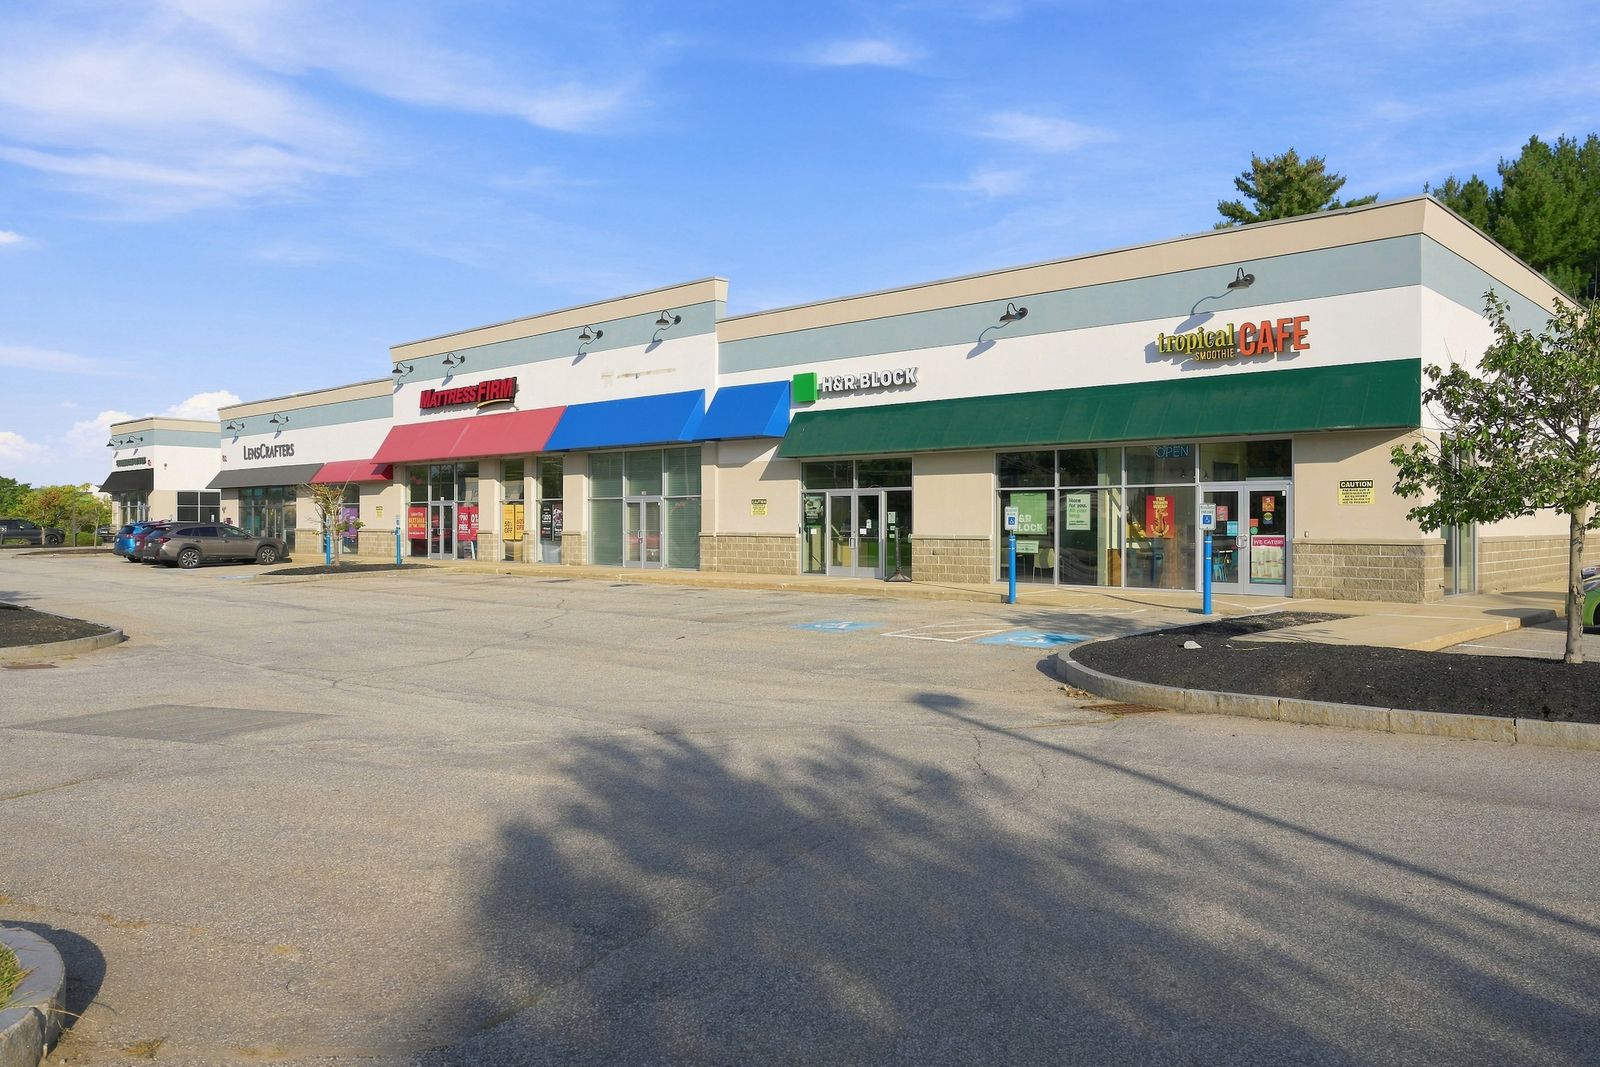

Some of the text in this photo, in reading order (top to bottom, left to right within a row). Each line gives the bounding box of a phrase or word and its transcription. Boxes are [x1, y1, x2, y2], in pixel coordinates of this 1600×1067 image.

[1158, 315, 1310, 356] tropical CAFE
[1195, 349, 1235, 361] SMOOTHIE
[822, 367, 918, 392] H&R BLOCK
[1156, 446, 1190, 458] OPEN
